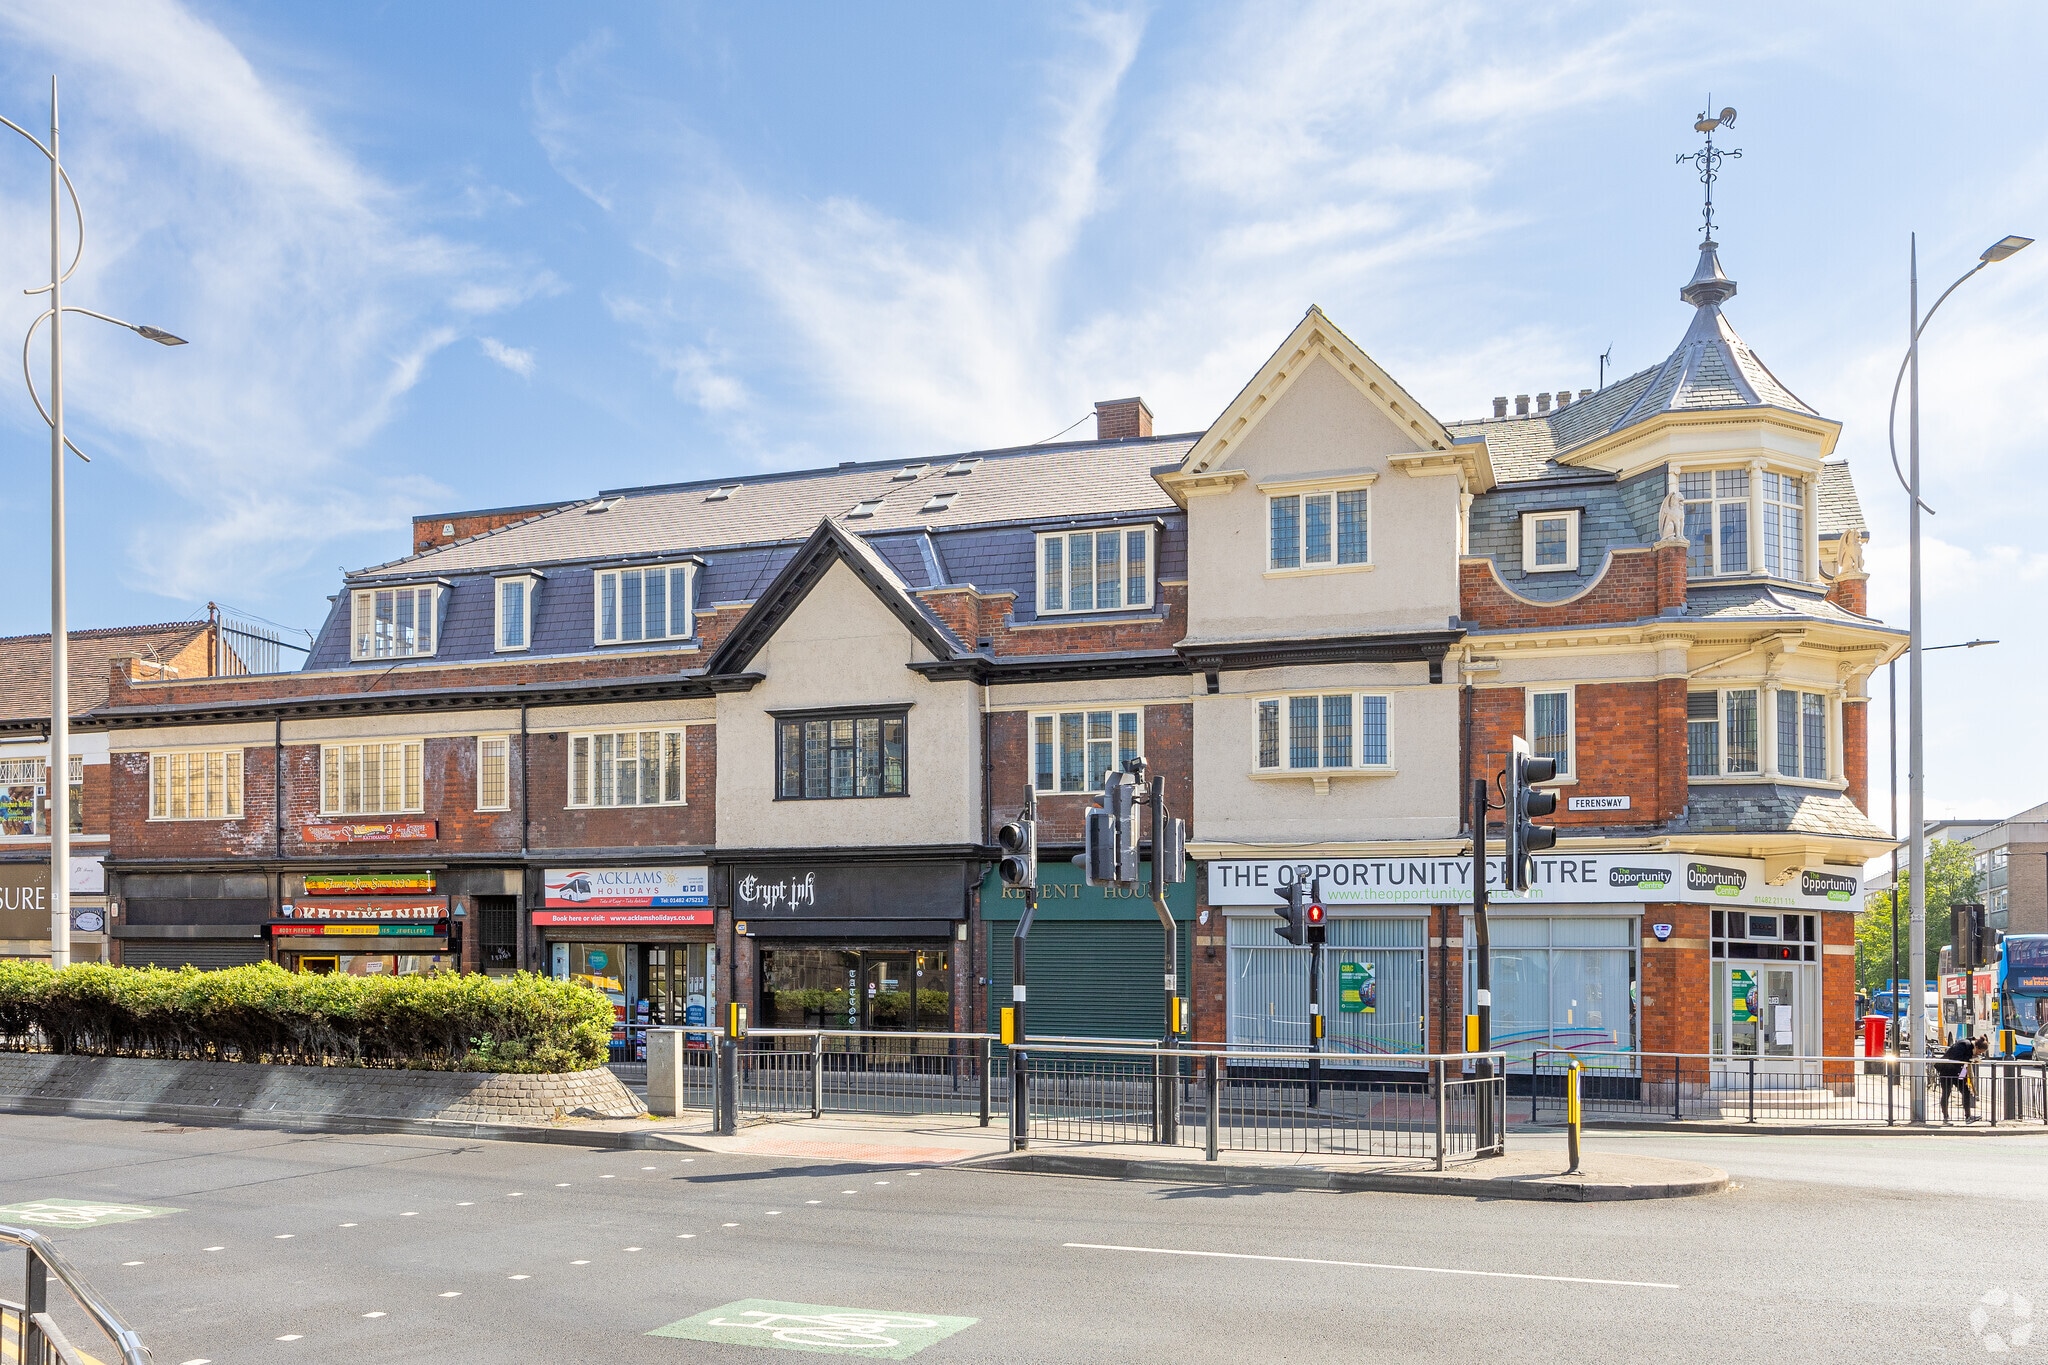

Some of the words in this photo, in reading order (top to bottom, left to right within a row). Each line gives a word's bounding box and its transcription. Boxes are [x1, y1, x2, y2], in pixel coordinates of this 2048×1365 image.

[1575, 799, 1623, 808] FERENSWAY
[1696, 865, 1707, 873] The
[597, 871, 662, 885] ACKLAMS
[1218, 865, 1269, 887] THE
[1610, 871, 1671, 884] Opportunity
[1688, 869, 1746, 888] Opportunity
[1810, 872, 1819, 880] The
[324, 878, 351, 892] Family
[1640, 881, 1663, 889] Centre
[1803, 875, 1856, 894] Opportunity
[738, 873, 787, 911] Crypt
[1716, 886, 1739, 897] Centre
[590, 914, 606, 922] visit:
[610, 914, 695, 922] www.acklamsholidays.co.uk
